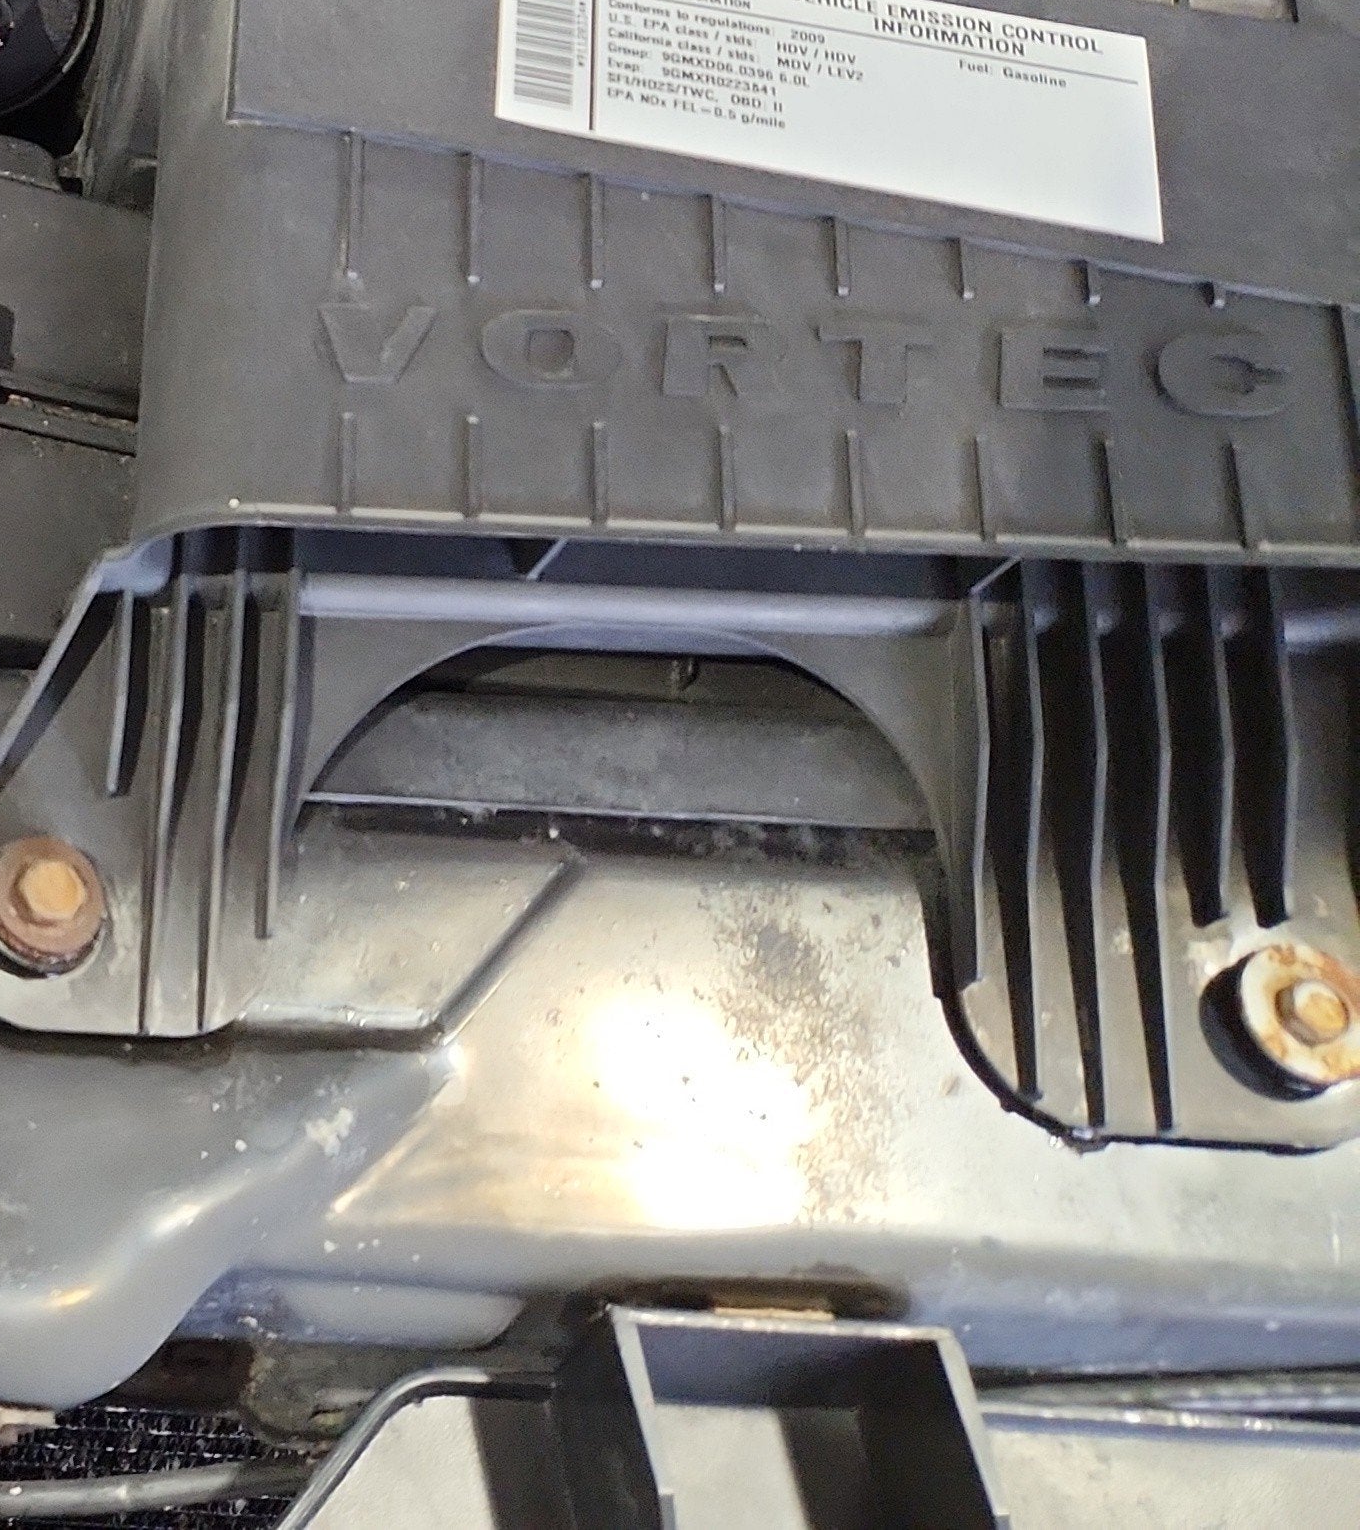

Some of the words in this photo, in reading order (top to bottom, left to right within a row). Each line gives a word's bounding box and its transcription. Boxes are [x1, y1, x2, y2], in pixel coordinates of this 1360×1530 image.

[643, 18, 670, 32] EPA
[676, 25, 709, 40] class
[777, 42, 808, 55] HDV
[824, 51, 857, 64] HDV
[677, 10, 689, 20] to
[695, 15, 775, 35] regulations:
[791, 29, 825, 44] 2009
[873, 17, 1025, 56] INFORMATION
[887, 4, 992, 33] EMISSION
[1002, 24, 1103, 54] CONTROL
[608, 43, 651, 60] Group:
[608, 28, 672, 49] California
[678, 40, 712, 57] class
[777, 58, 811, 72] MDV
[827, 66, 864, 82] LEV2
[959, 60, 993, 76] Fuel:
[1003, 67, 1067, 88] Gasoline
[608, 88, 634, 101] EPA
[641, 93, 667, 107] NOx
[741, 112, 785, 128] g/mile
[316, 300, 1290, 422] VORTEC
